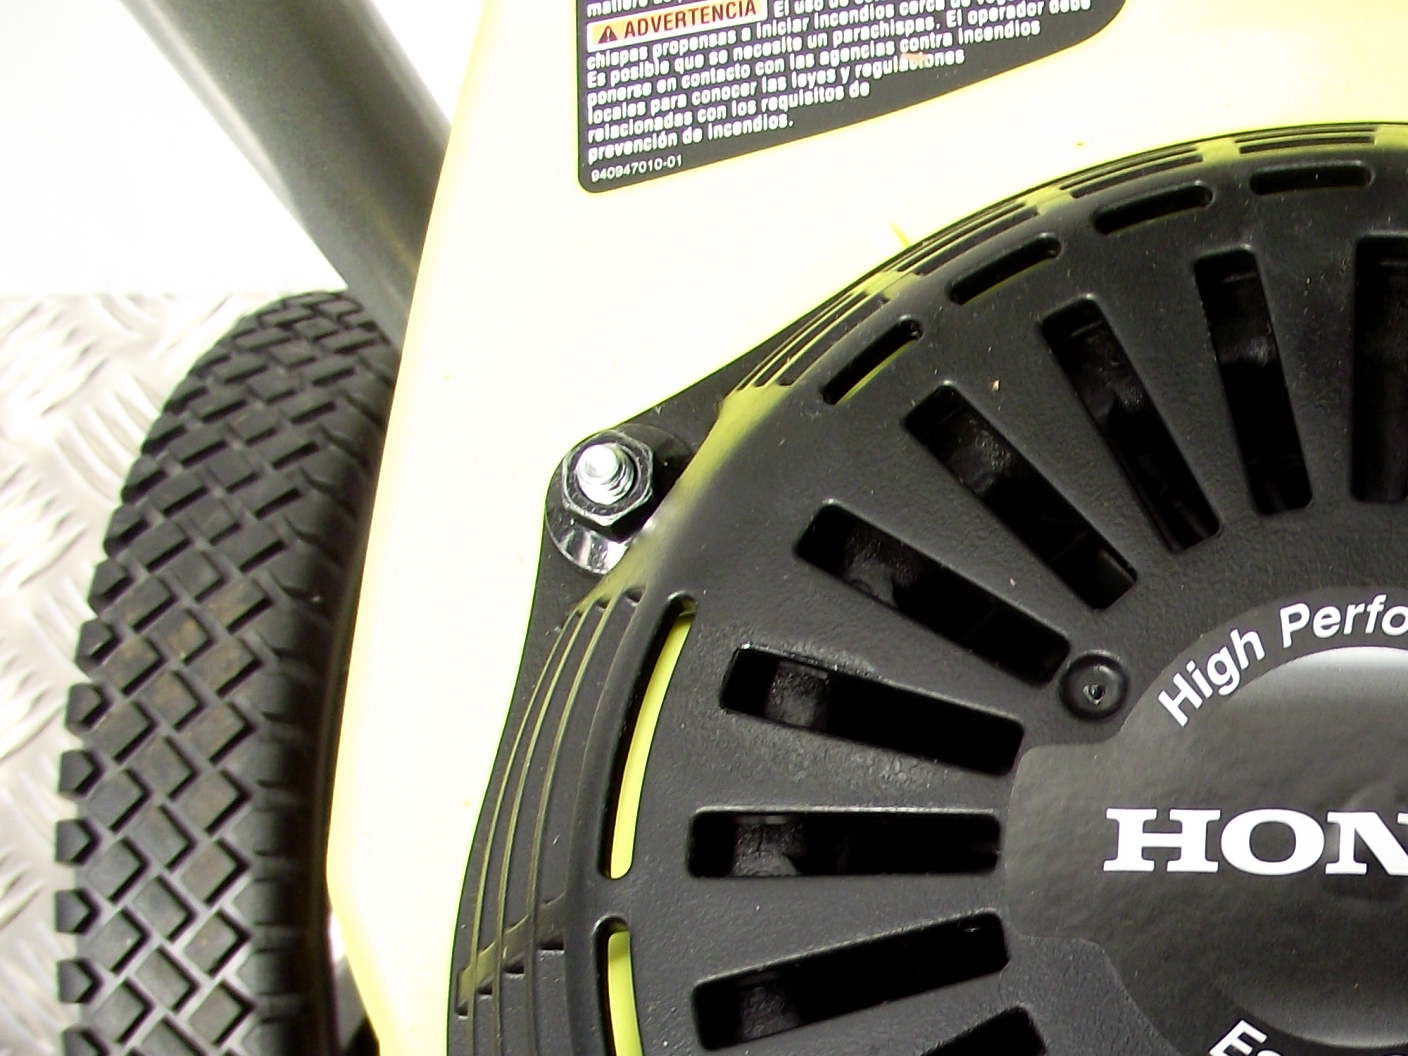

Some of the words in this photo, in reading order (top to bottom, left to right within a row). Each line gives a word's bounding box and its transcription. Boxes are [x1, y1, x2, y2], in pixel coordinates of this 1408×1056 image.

[587, 46, 648, 70] chispas
[653, 29, 737, 60] propensas
[741, 27, 751, 41] a
[756, 16, 809, 39] iniciar
[814, 2, 895, 30] incendios
[899, 0, 945, 16] cerca
[587, 71, 606, 89] Es
[610, 59, 670, 87] posible
[674, 54, 705, 75] que
[708, 49, 728, 65] se
[732, 35, 803, 61] necesite
[807, 32, 828, 49] un
[946, 9, 963, 28] El
[967, 1, 1045, 27] operador
[624, 0, 757, 39] ADVERTENCIA
[774, 0, 790, 18] El
[794, 0, 824, 14] uso
[587, 81, 652, 107] ponerse
[656, 77, 677, 94] en
[681, 63, 751, 89] contacto
[755, 58, 785, 76] con
[790, 52, 815, 70] las
[819, 40, 895, 67] agencias
[900, 31, 953, 53] contra
[958, 20, 1041, 45] incendios
[588, 101, 646, 125] locales
[651, 93, 687, 116] para
[692, 80, 757, 105] conocer
[762, 75, 787, 94] las
[791, 68, 836, 89] leyes
[840, 65, 850, 85] y
[855, 49, 965, 79] regulaciones
[588, 111, 693, 144] relacionadas
[697, 104, 727, 124] con
[731, 99, 757, 117] los
[761, 86, 845, 113] requisitos
[849, 80, 870, 98] de
[588, 131, 678, 166] prevención
[682, 127, 702, 144] de
[707, 113, 794, 141] incendios.
[591, 154, 683, 182] 940947010-01
[1158, 628, 1266, 728] High
